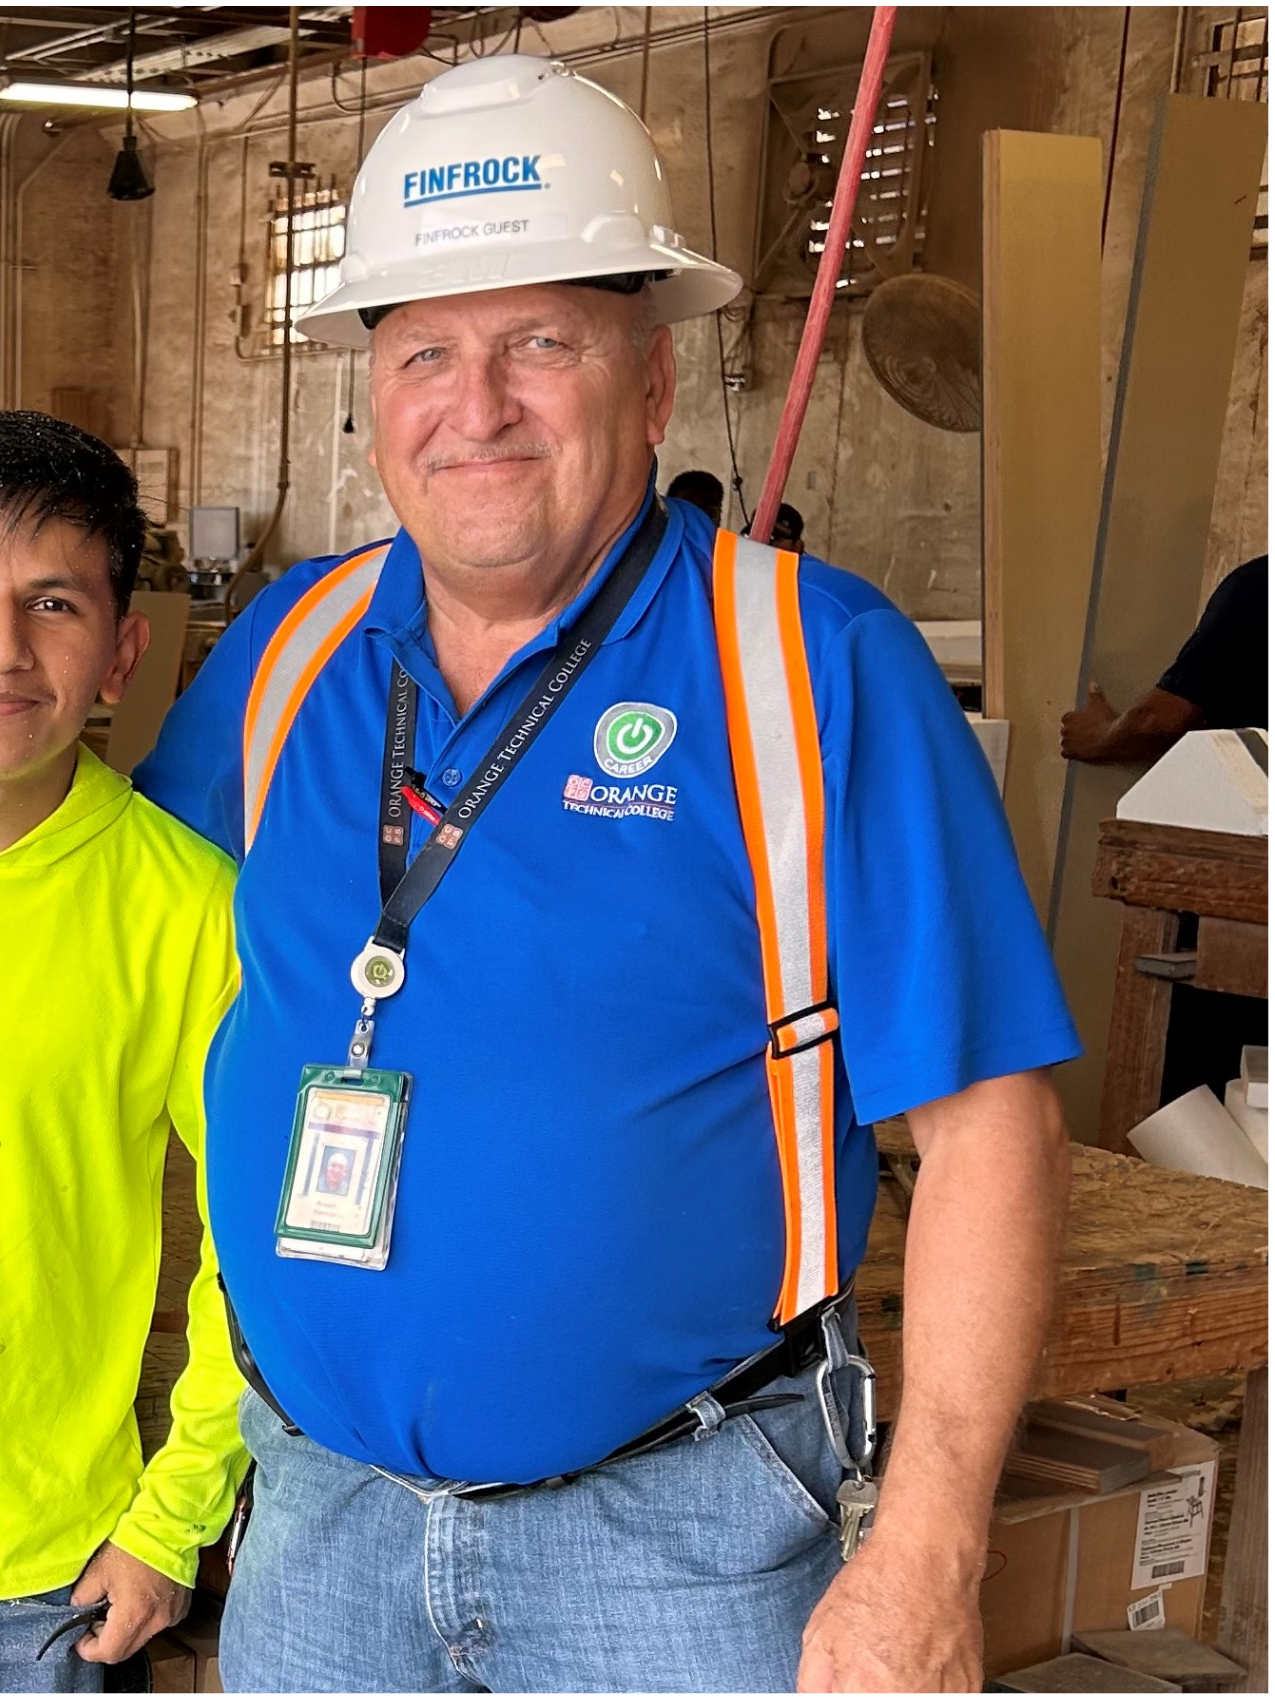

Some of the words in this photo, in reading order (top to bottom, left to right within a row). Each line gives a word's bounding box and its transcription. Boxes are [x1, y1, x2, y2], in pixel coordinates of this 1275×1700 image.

[403, 155, 541, 200] FINFROCK
[415, 225, 479, 246] FINFROCK
[482, 219, 529, 236] GUEST
[392, 688, 409, 759] TECHNICAL
[458, 762, 505, 819] ORANGE
[497, 694, 554, 763] TECHNICAL
[548, 638, 592, 693] COLLEGE
[604, 756, 653, 775] CAREER
[388, 762, 405, 818] ORANGE
[590, 784, 678, 805] ORANGE
[562, 800, 625, 819] TECHNICAL
[625, 804, 675, 821] COLLEGE
